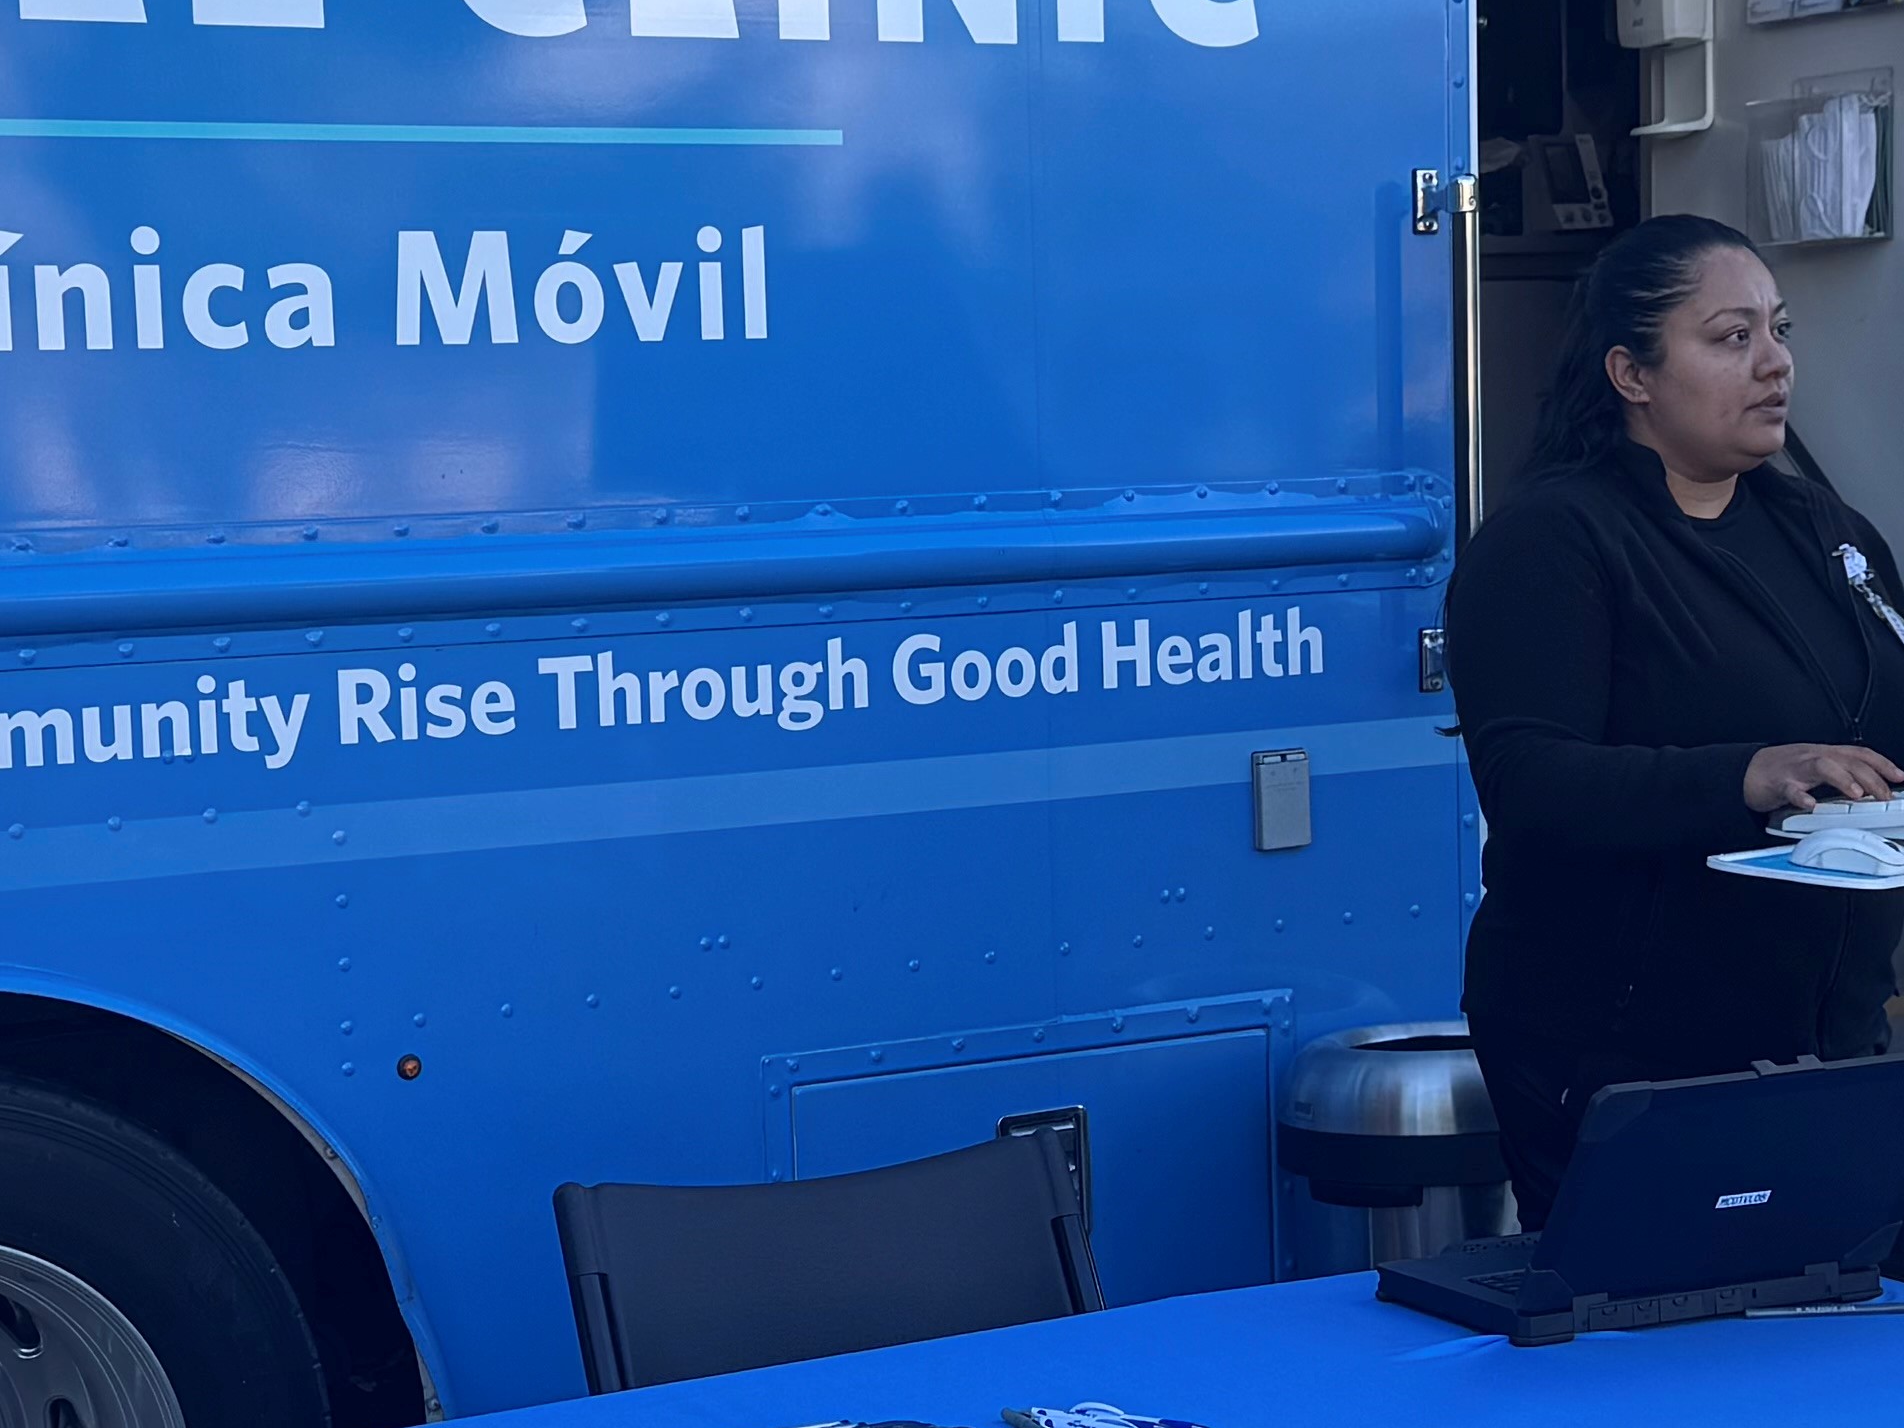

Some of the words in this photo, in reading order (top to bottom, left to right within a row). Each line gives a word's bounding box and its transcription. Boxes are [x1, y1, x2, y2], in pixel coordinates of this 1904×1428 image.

[397, 225, 768, 346] Móvil
[338, 662, 516, 745] Rise
[538, 636, 869, 731] Through
[893, 620, 1079, 705] Good
[1101, 606, 1324, 690] Health
